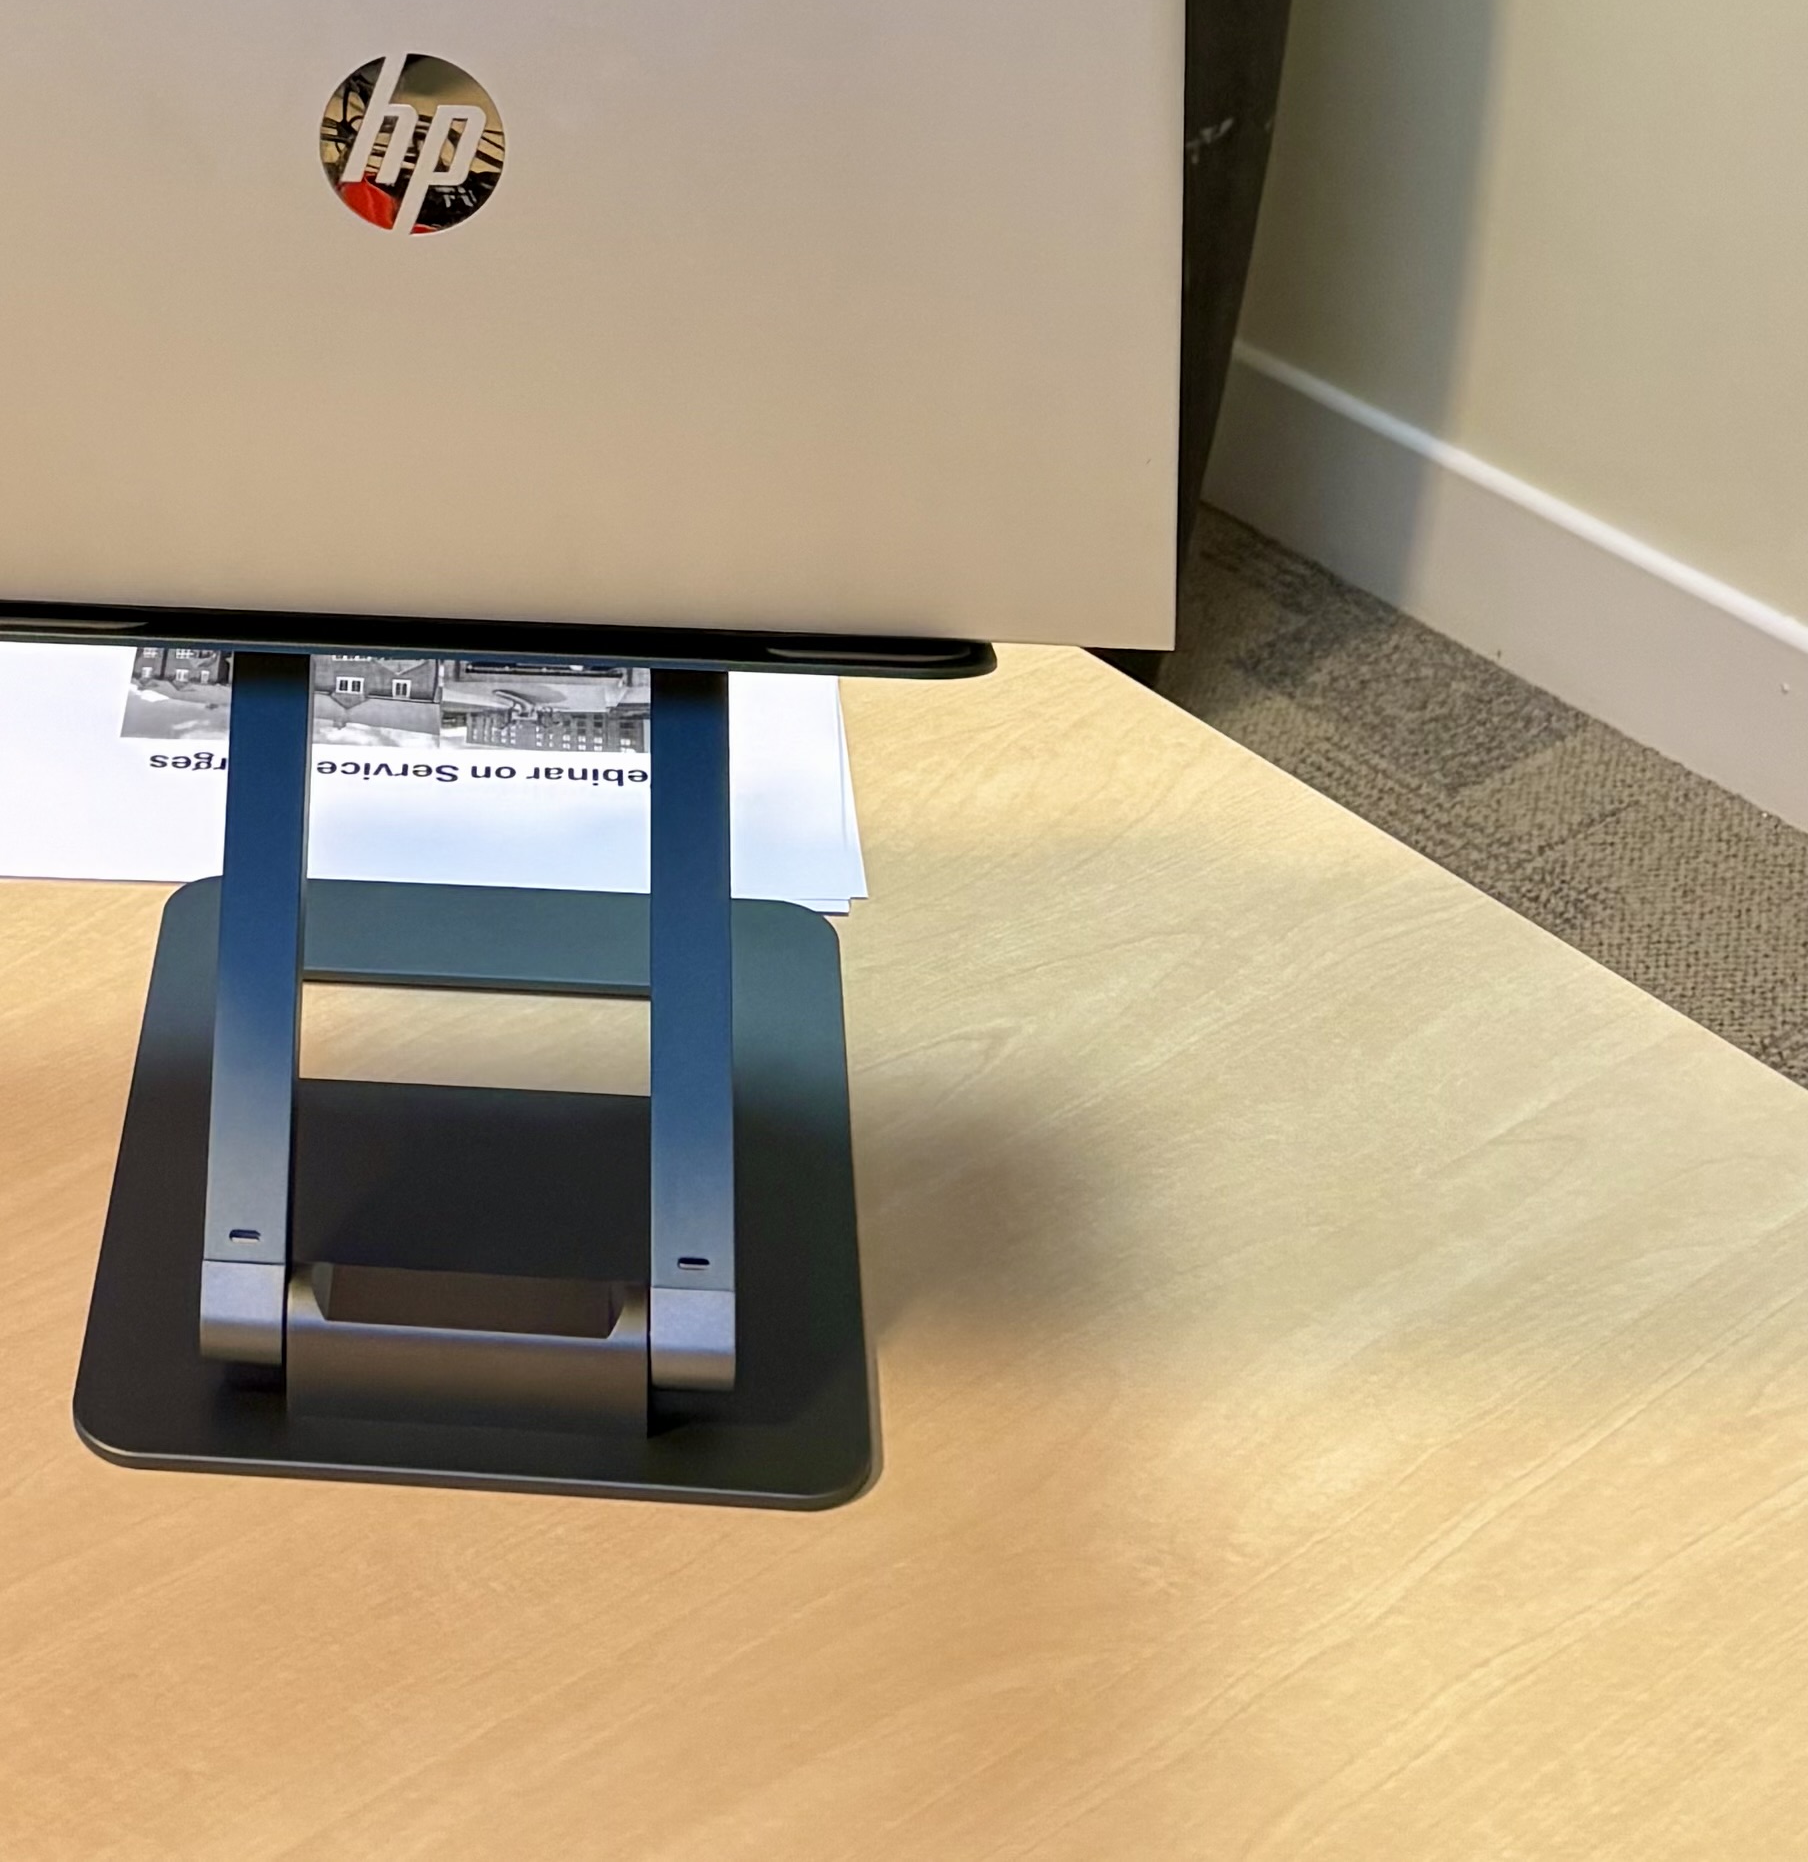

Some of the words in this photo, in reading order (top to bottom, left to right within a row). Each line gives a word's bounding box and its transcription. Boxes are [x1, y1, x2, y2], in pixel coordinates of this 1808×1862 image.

[339, 54, 487, 236] hp
[148, 753, 228, 771] rges
[316, 758, 460, 783] Service
[470, 765, 518, 780] on
[525, 764, 650, 787] ebinar
